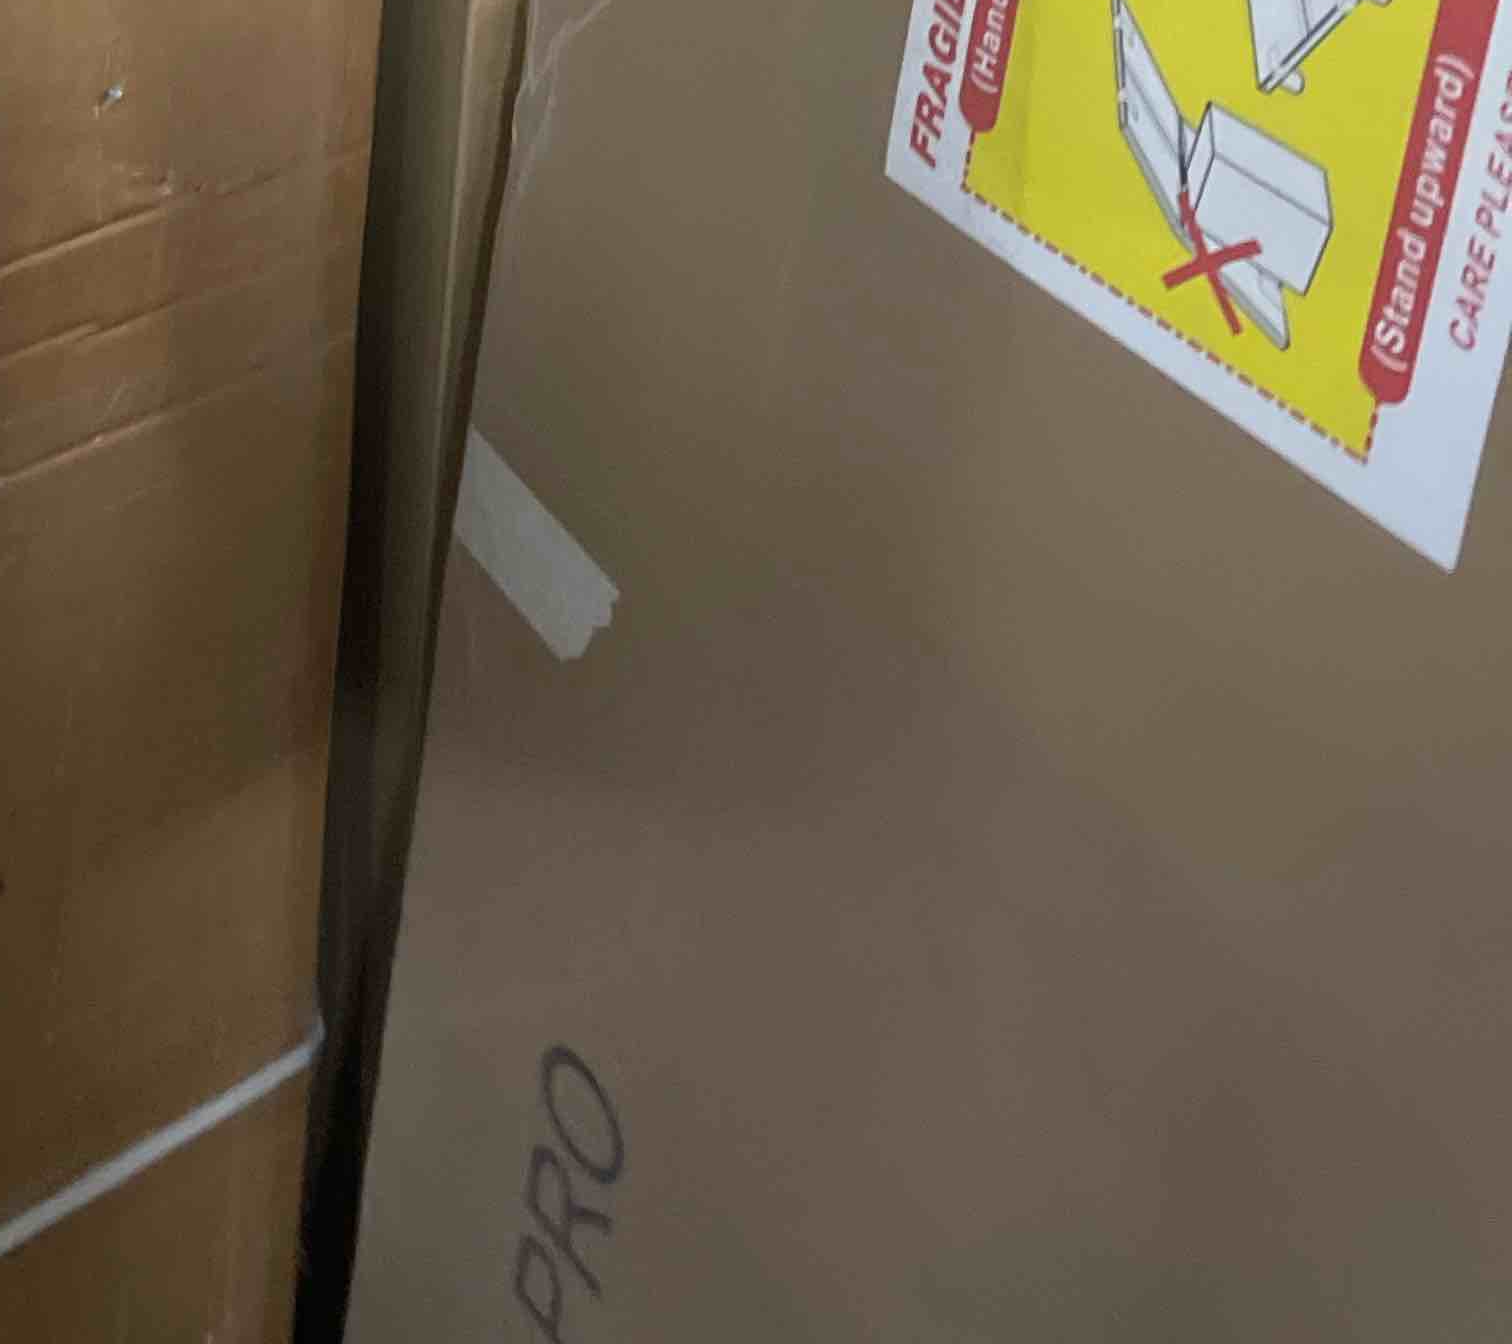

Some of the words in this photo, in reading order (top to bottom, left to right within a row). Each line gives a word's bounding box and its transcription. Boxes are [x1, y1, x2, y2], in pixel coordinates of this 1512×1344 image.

[1371, 226, 1427, 373] (Stand
[1410, 52, 1476, 228] upward)
[1450, 235, 1496, 352] CARE
[1475, 69, 1512, 239] PLEA
